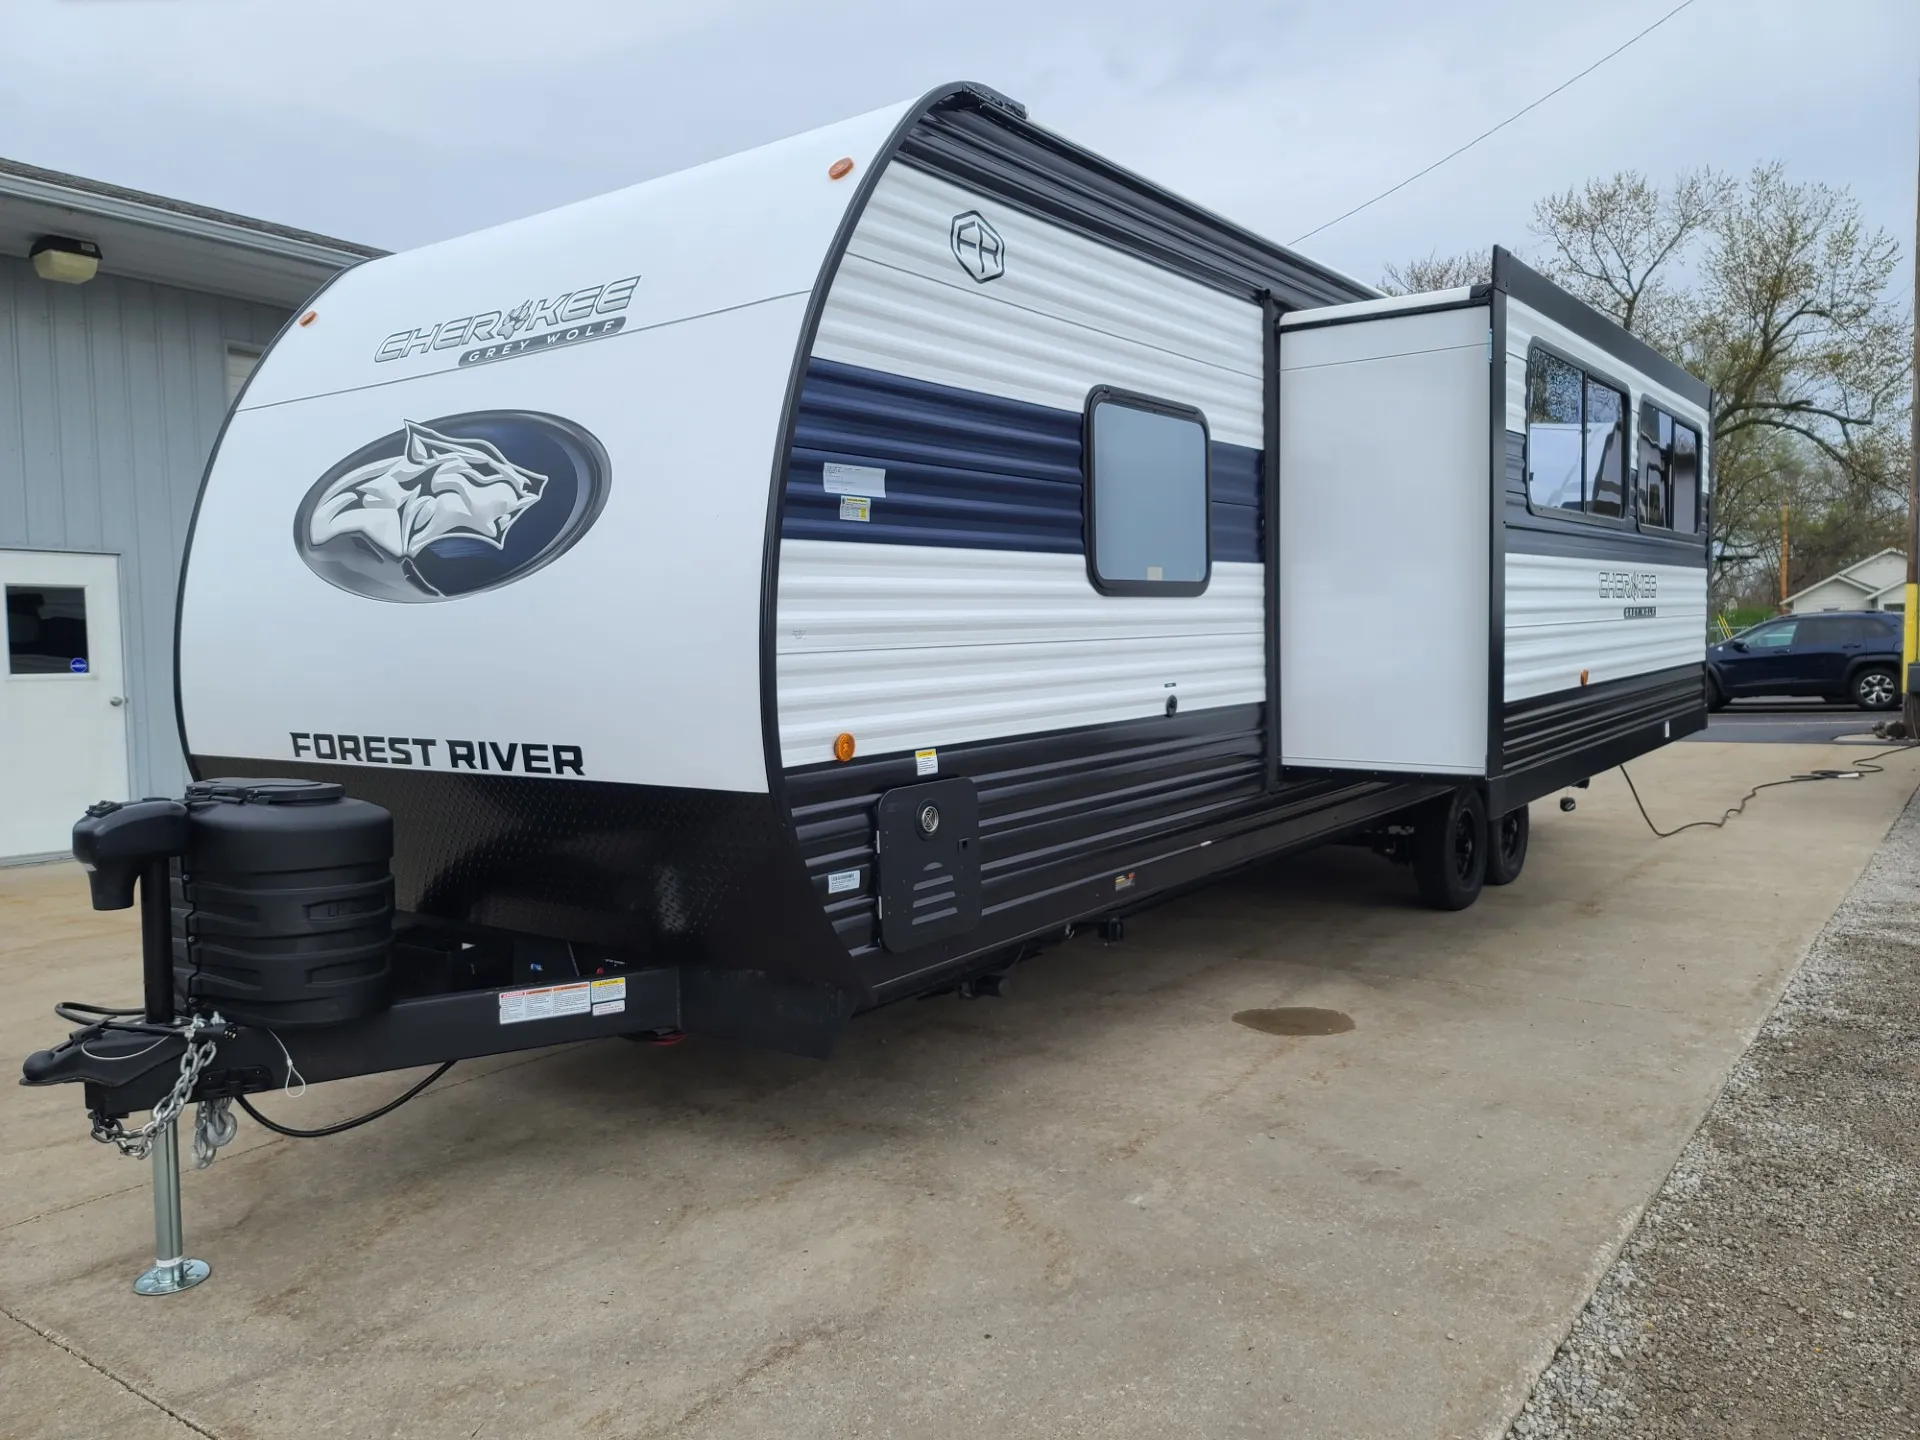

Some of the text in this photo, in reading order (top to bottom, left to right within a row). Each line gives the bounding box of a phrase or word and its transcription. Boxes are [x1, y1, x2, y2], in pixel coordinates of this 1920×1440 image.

[468, 319, 615, 362] GREY WOLF
[289, 731, 586, 776] FOREST RIVER
